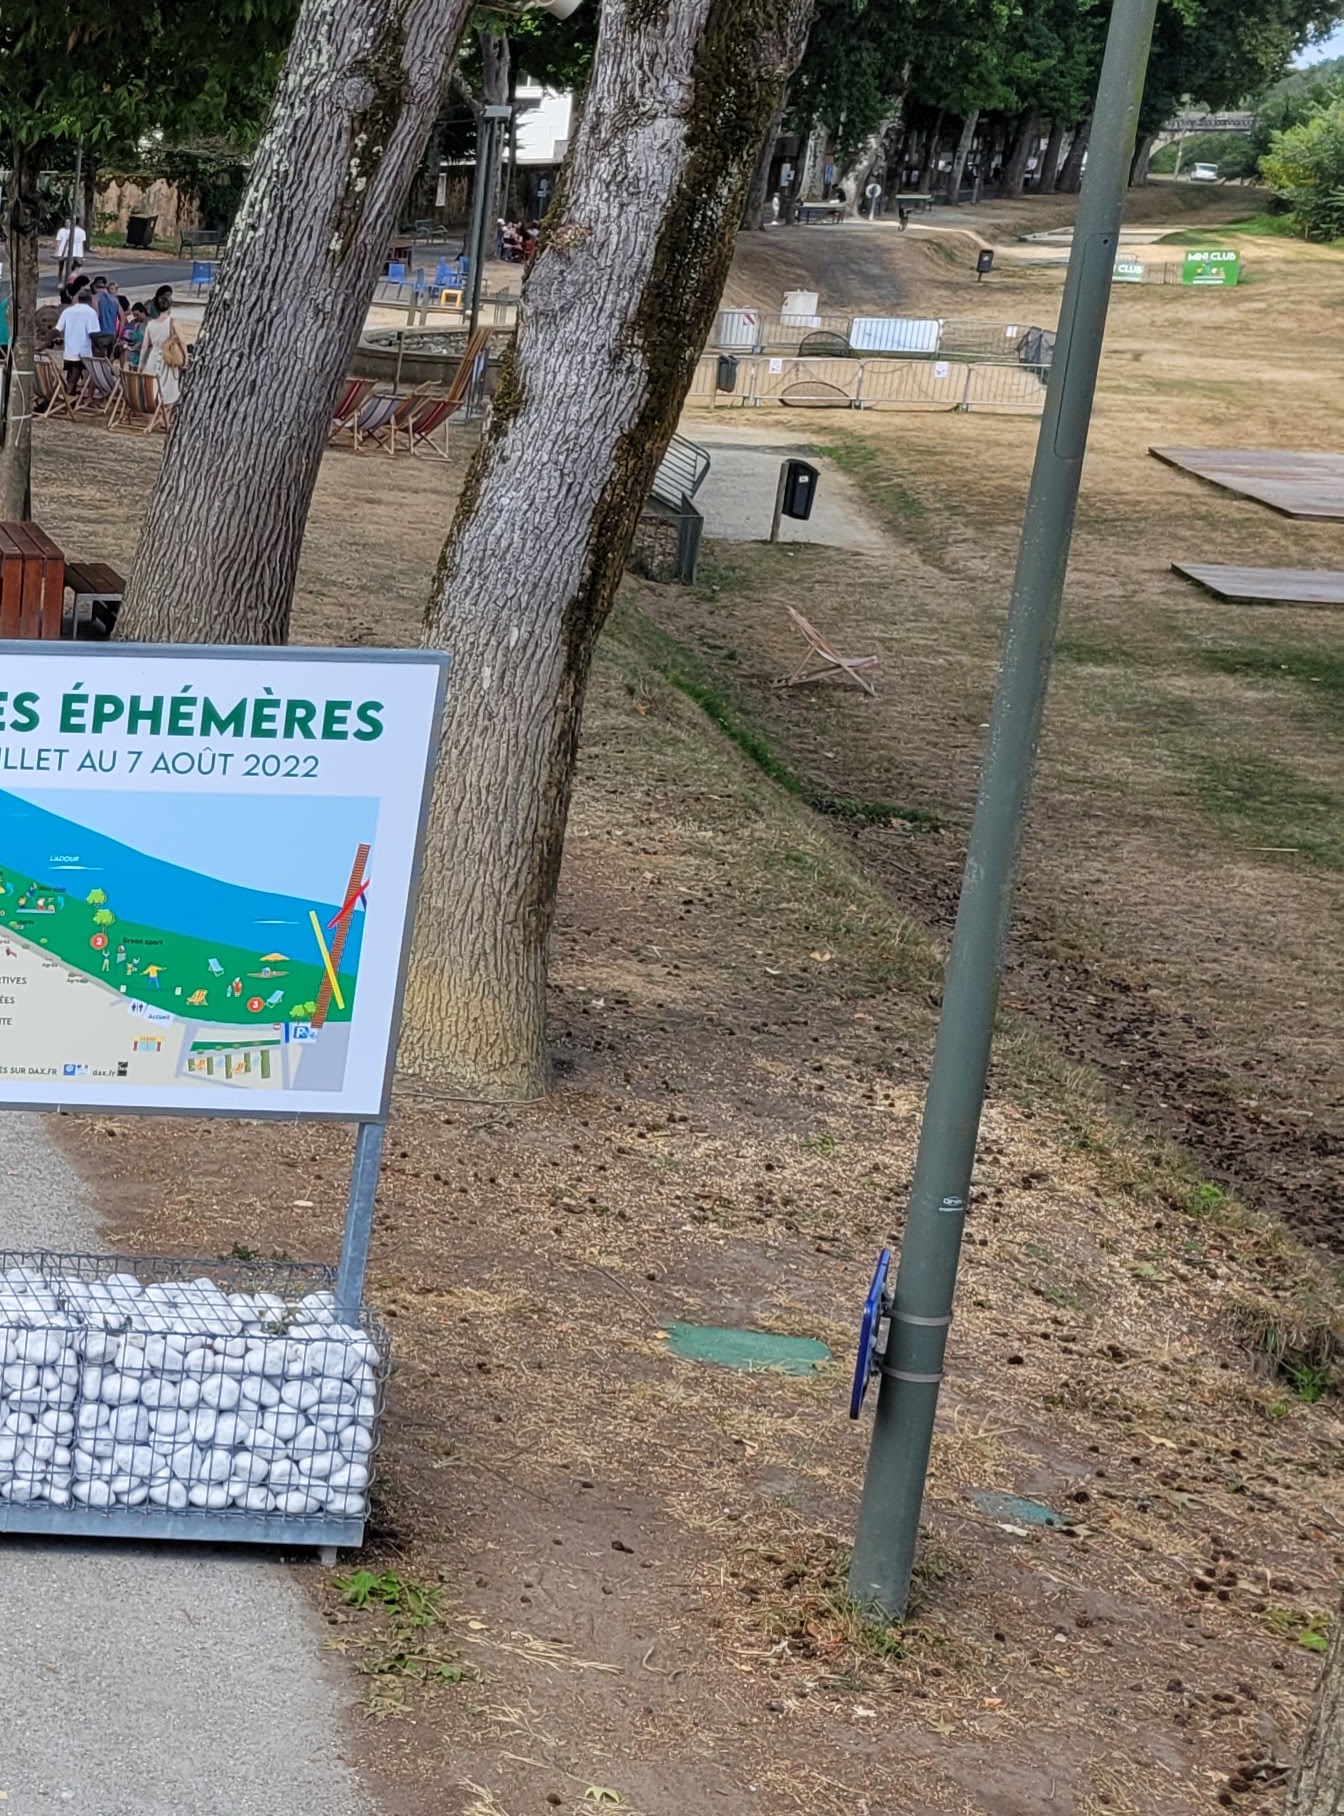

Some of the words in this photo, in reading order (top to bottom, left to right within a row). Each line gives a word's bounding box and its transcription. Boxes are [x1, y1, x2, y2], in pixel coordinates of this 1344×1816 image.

[1188, 252, 1209, 261] MINI
[1211, 252, 1236, 260] CLUB
[1118, 264, 1143, 274] CLUB
[59, 681, 385, 742] ÉPHÉMÈRES
[76, 749, 118, 774] AU
[127, 751, 143, 774] 7
[150, 746, 234, 776] AOÛT
[241, 754, 320, 778] 2022
[9, 1066, 27, 1074] SUR
[28, 1066, 58, 1076] DAX.FR
